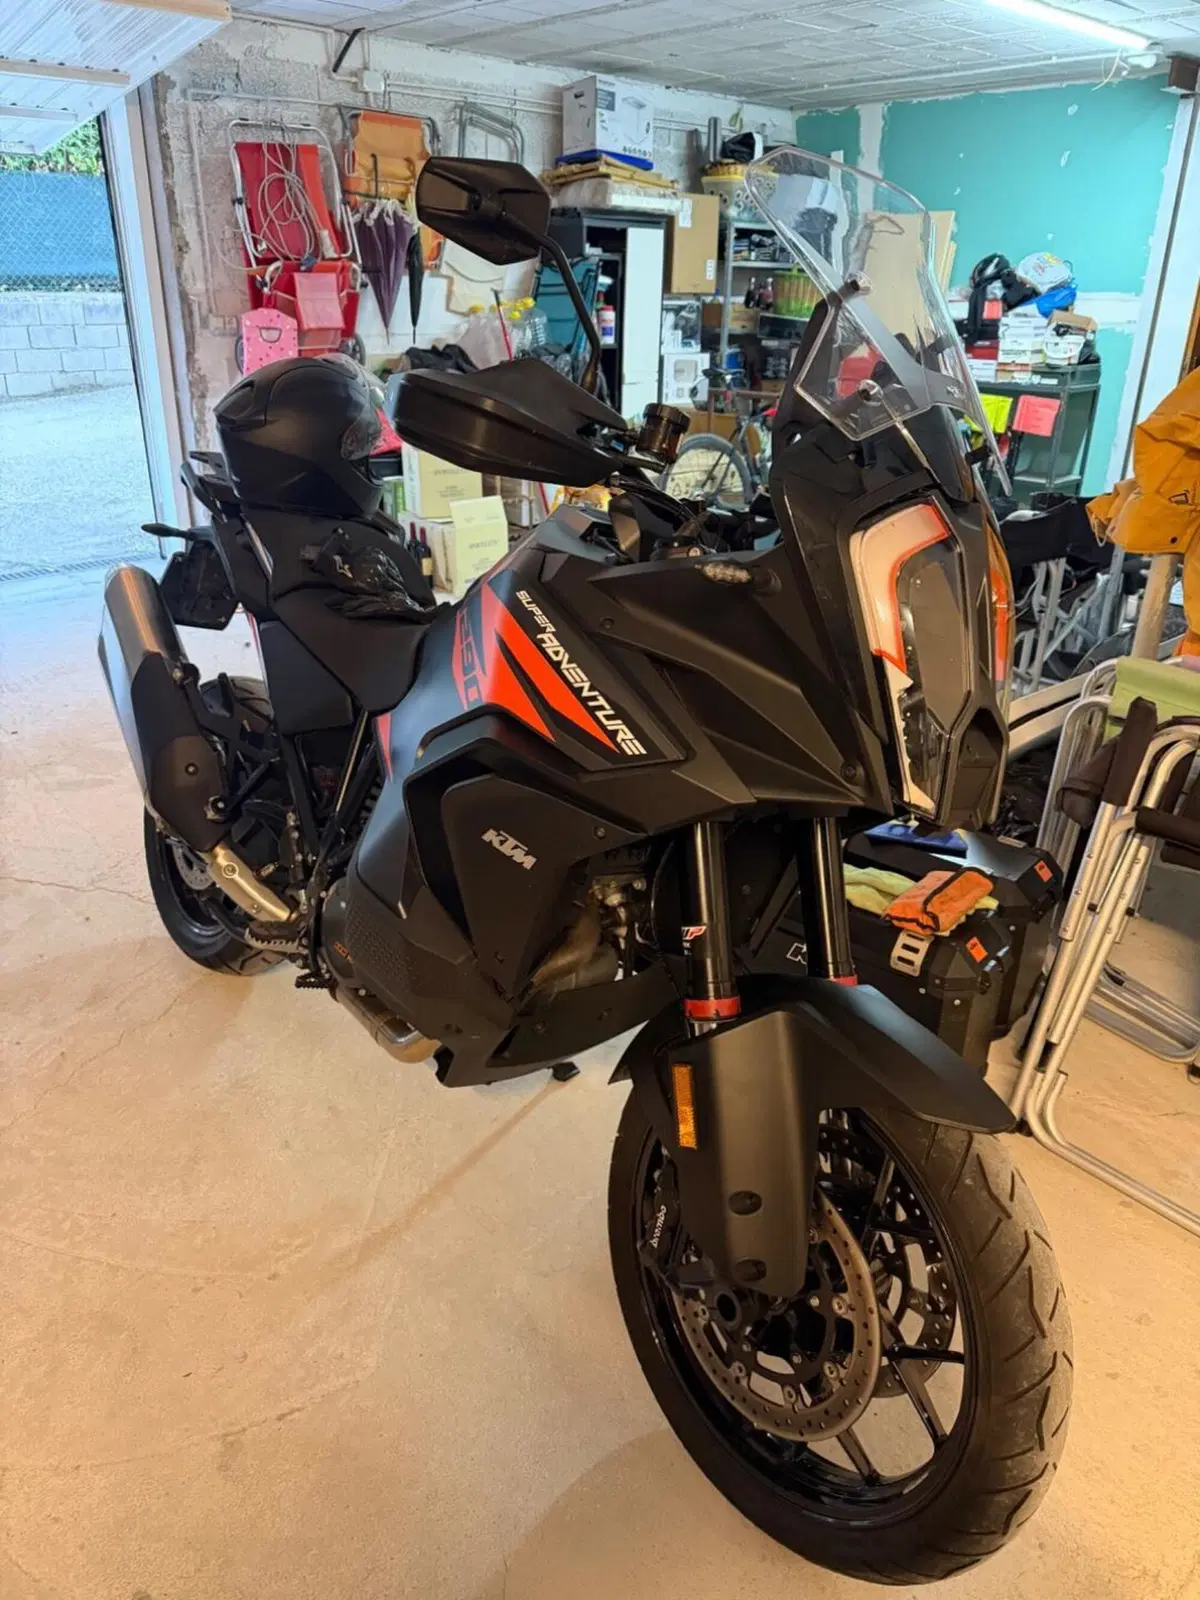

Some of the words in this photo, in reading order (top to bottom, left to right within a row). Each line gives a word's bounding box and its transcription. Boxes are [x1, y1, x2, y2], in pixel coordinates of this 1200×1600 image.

[515, 589, 557, 633] SUPER
[536, 632, 648, 756] ADVENTURE
[481, 829, 538, 870] KTM
